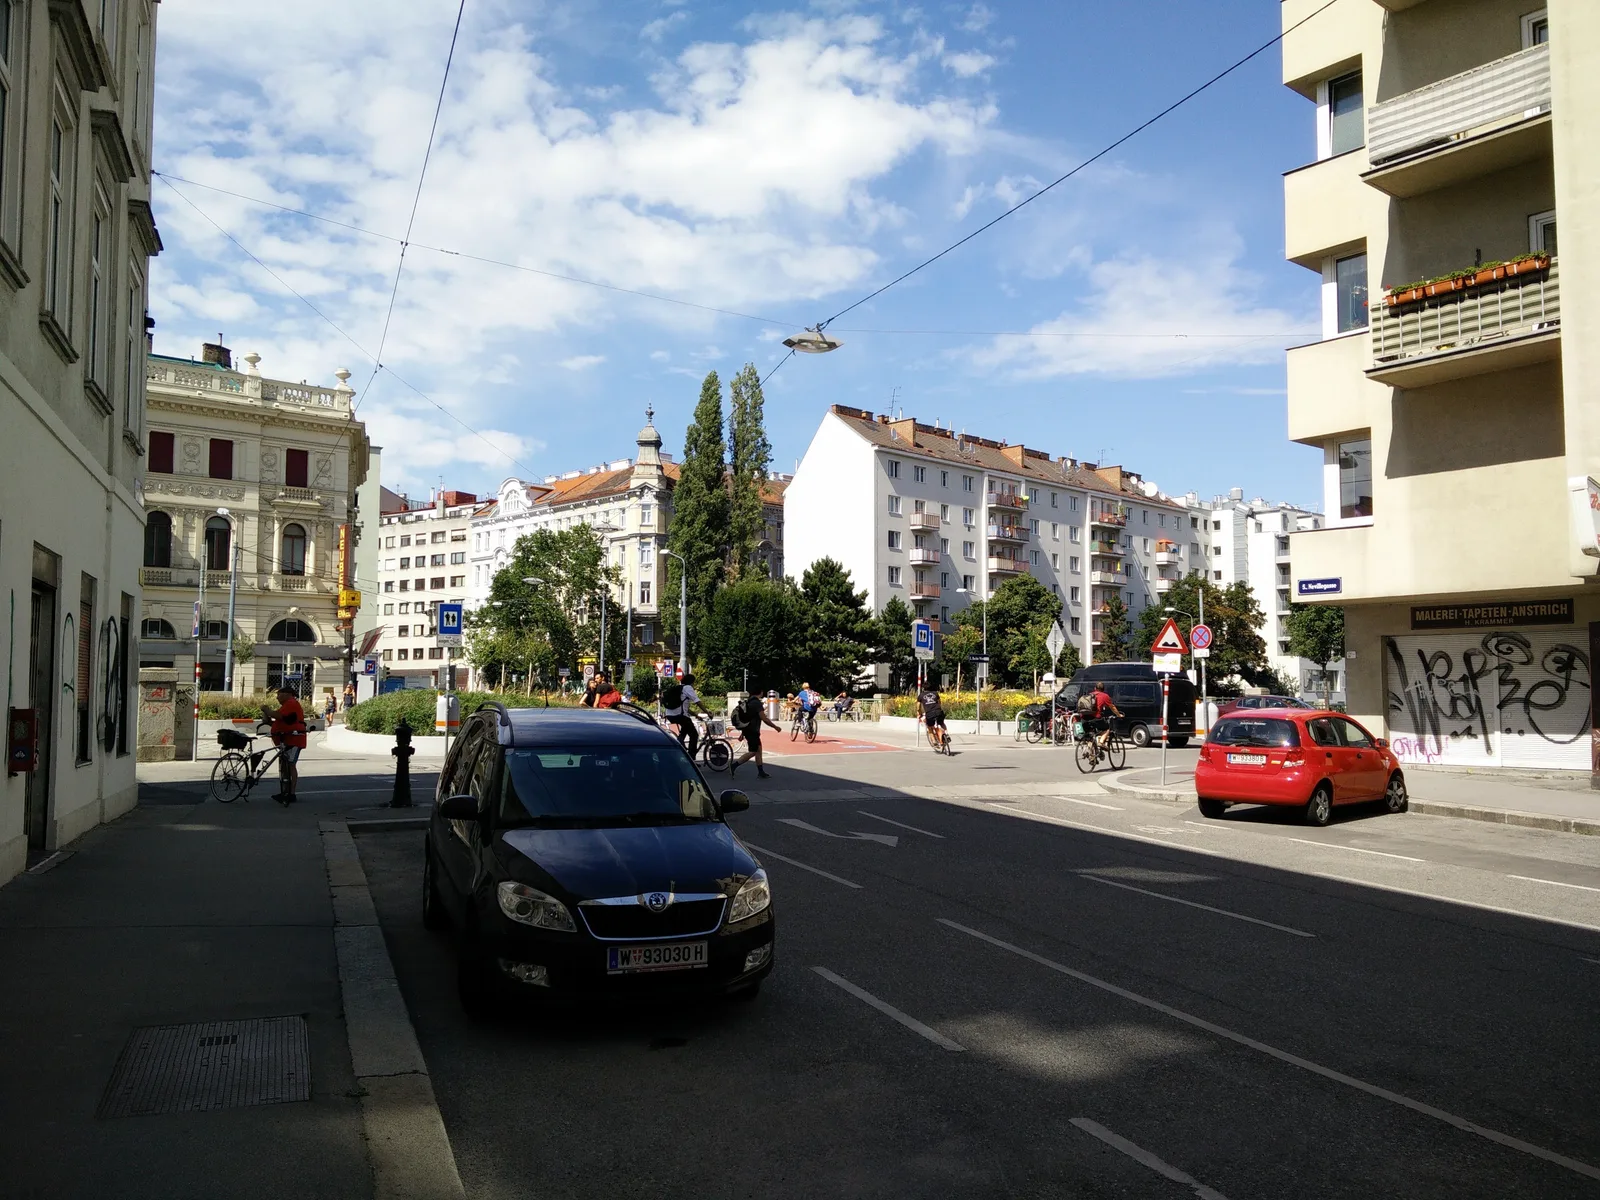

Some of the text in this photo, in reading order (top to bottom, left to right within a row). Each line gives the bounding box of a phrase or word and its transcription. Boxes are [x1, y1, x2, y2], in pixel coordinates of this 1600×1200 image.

[1475, 617, 1514, 626] KRAMMER
[1020, 721, 1026, 730] P
[1075, 723, 1081, 735] P
[620, 950, 632, 966] W
